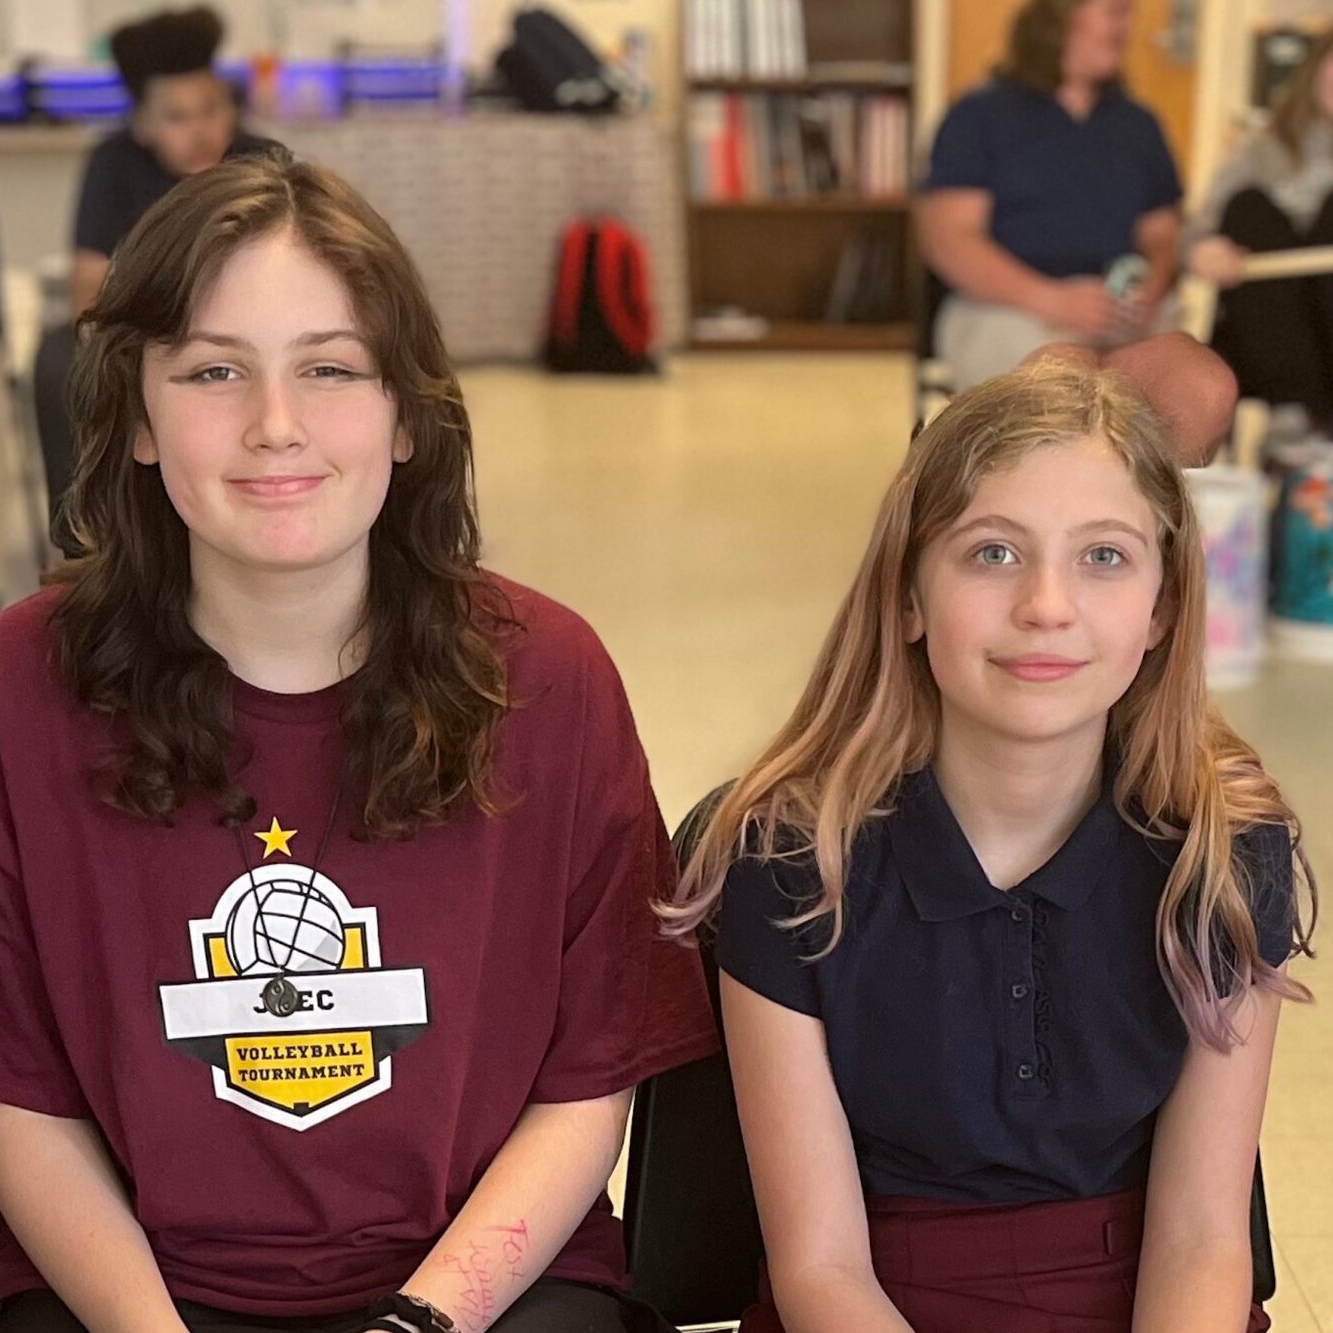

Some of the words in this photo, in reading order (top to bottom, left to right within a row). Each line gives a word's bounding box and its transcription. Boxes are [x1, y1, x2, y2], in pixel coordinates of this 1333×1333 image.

[253, 989, 335, 1014] JEC
[236, 1042, 363, 1061] VOLLEYBALL
[238, 1064, 365, 1082] TOURNAMENT
